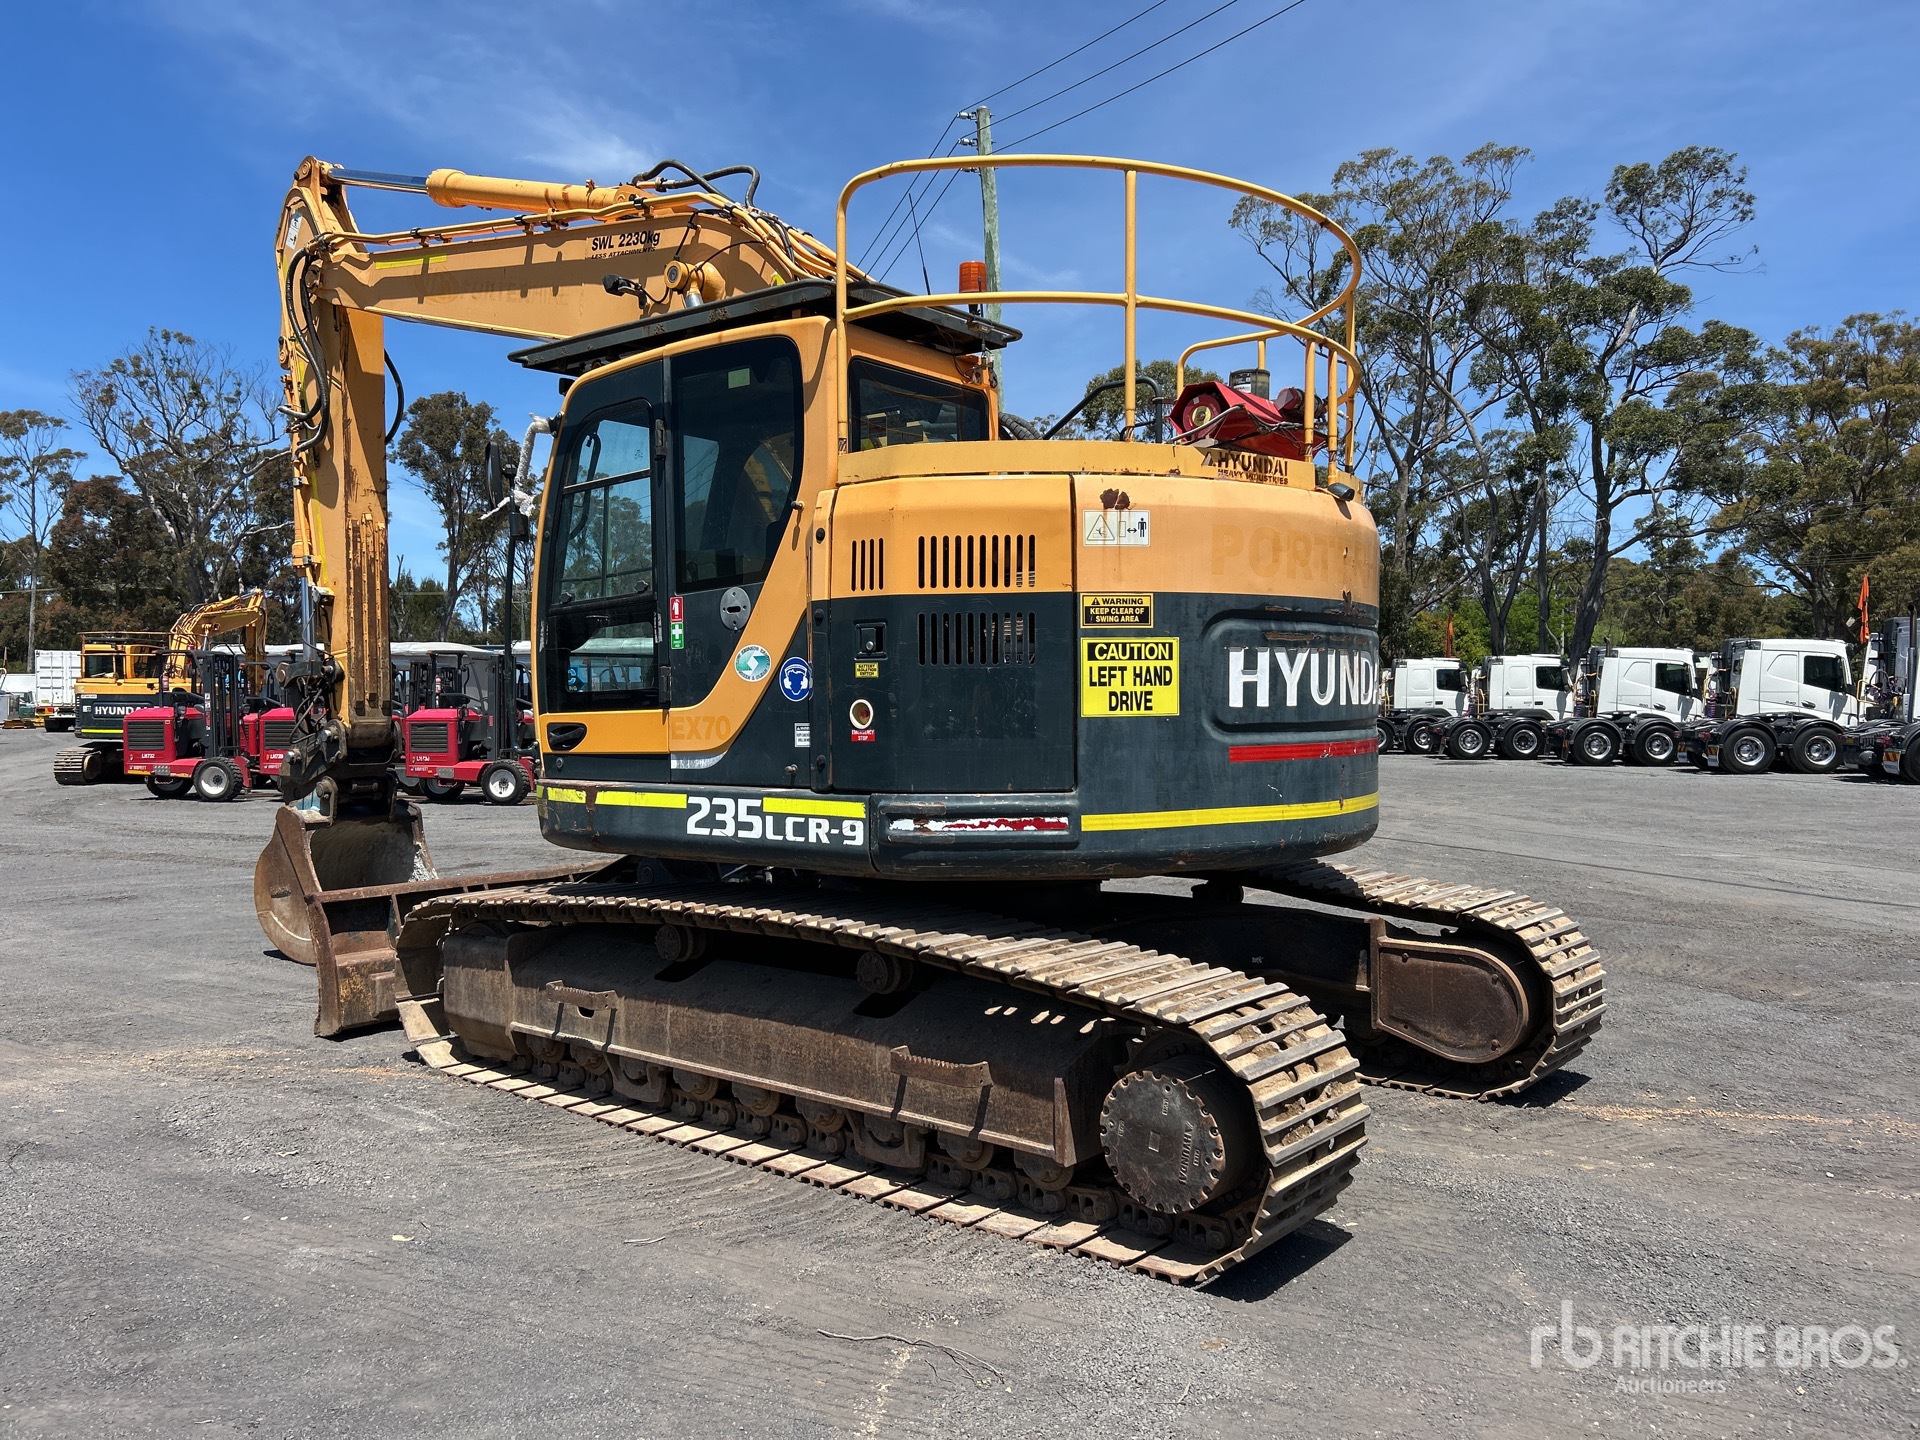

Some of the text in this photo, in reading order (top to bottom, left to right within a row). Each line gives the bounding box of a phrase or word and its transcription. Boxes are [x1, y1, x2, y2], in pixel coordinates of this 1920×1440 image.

[591, 230, 661, 251] SWL 2230kg
[591, 246, 656, 259] LESS ATTACHMENTS
[1217, 450, 1289, 477] HYUNDAI
[1217, 468, 1289, 485] HEAVY INDUSTRIES
[1101, 597, 1144, 605] WARNING
[1090, 607, 1145, 615] KEEP CLEAR OF
[1095, 615, 1140, 623] SWING AREA
[1094, 642, 1170, 660] CAUTION
[1089, 665, 1173, 687] LEFT HAND
[1108, 690, 1153, 711] DRIVE
[671, 715, 732, 741] EX70
